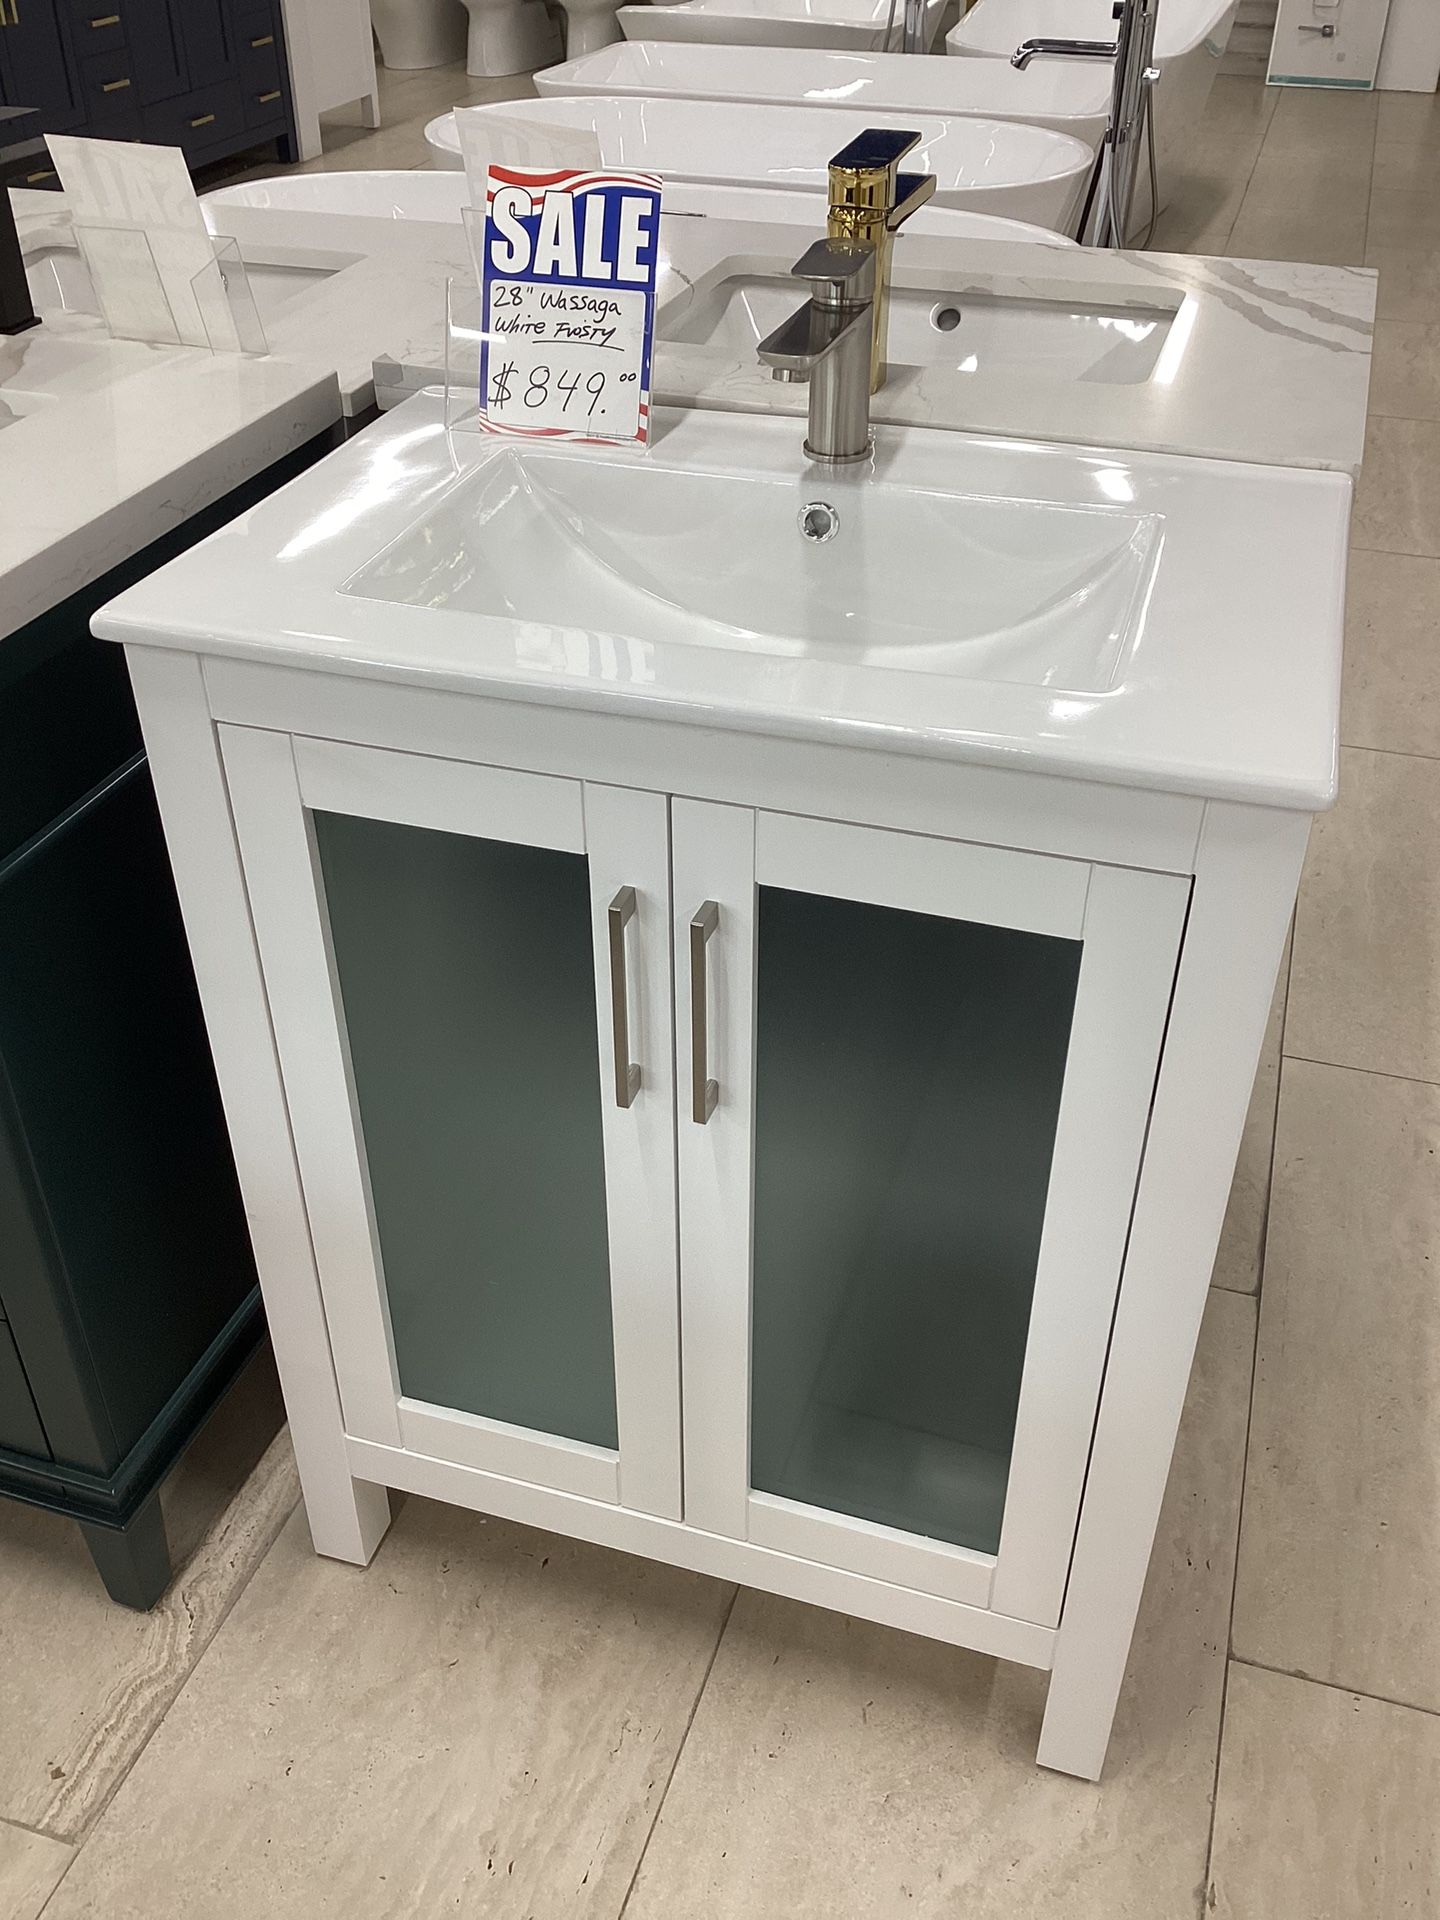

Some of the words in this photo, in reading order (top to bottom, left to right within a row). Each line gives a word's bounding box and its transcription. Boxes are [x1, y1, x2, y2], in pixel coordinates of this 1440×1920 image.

[491, 186, 653, 282] SALE
[493, 286, 533, 307] 28"
[540, 291, 622, 323] Wassaga
